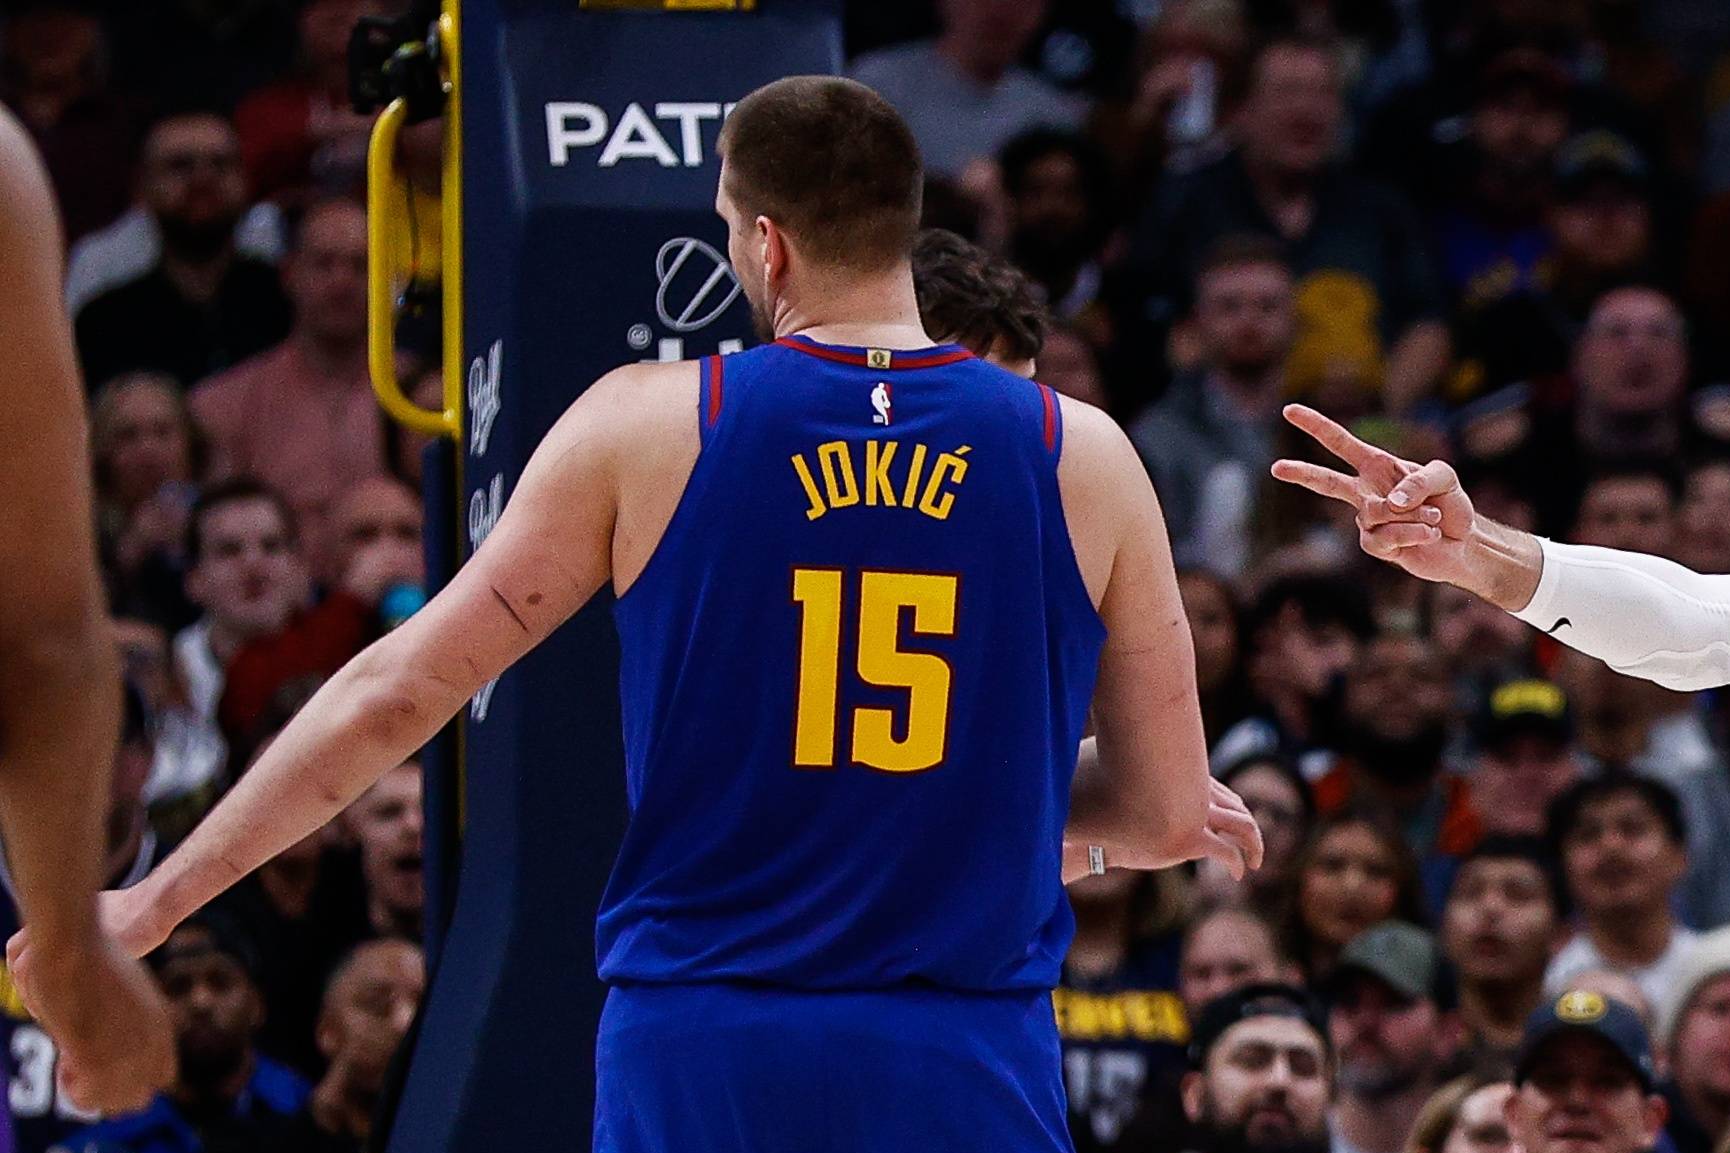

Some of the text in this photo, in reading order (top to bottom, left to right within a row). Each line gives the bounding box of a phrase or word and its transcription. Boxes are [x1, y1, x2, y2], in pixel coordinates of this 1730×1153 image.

[544, 102, 742, 168] PAT
[790, 439, 973, 522] JOKIĆ
[791, 566, 960, 774] 15
